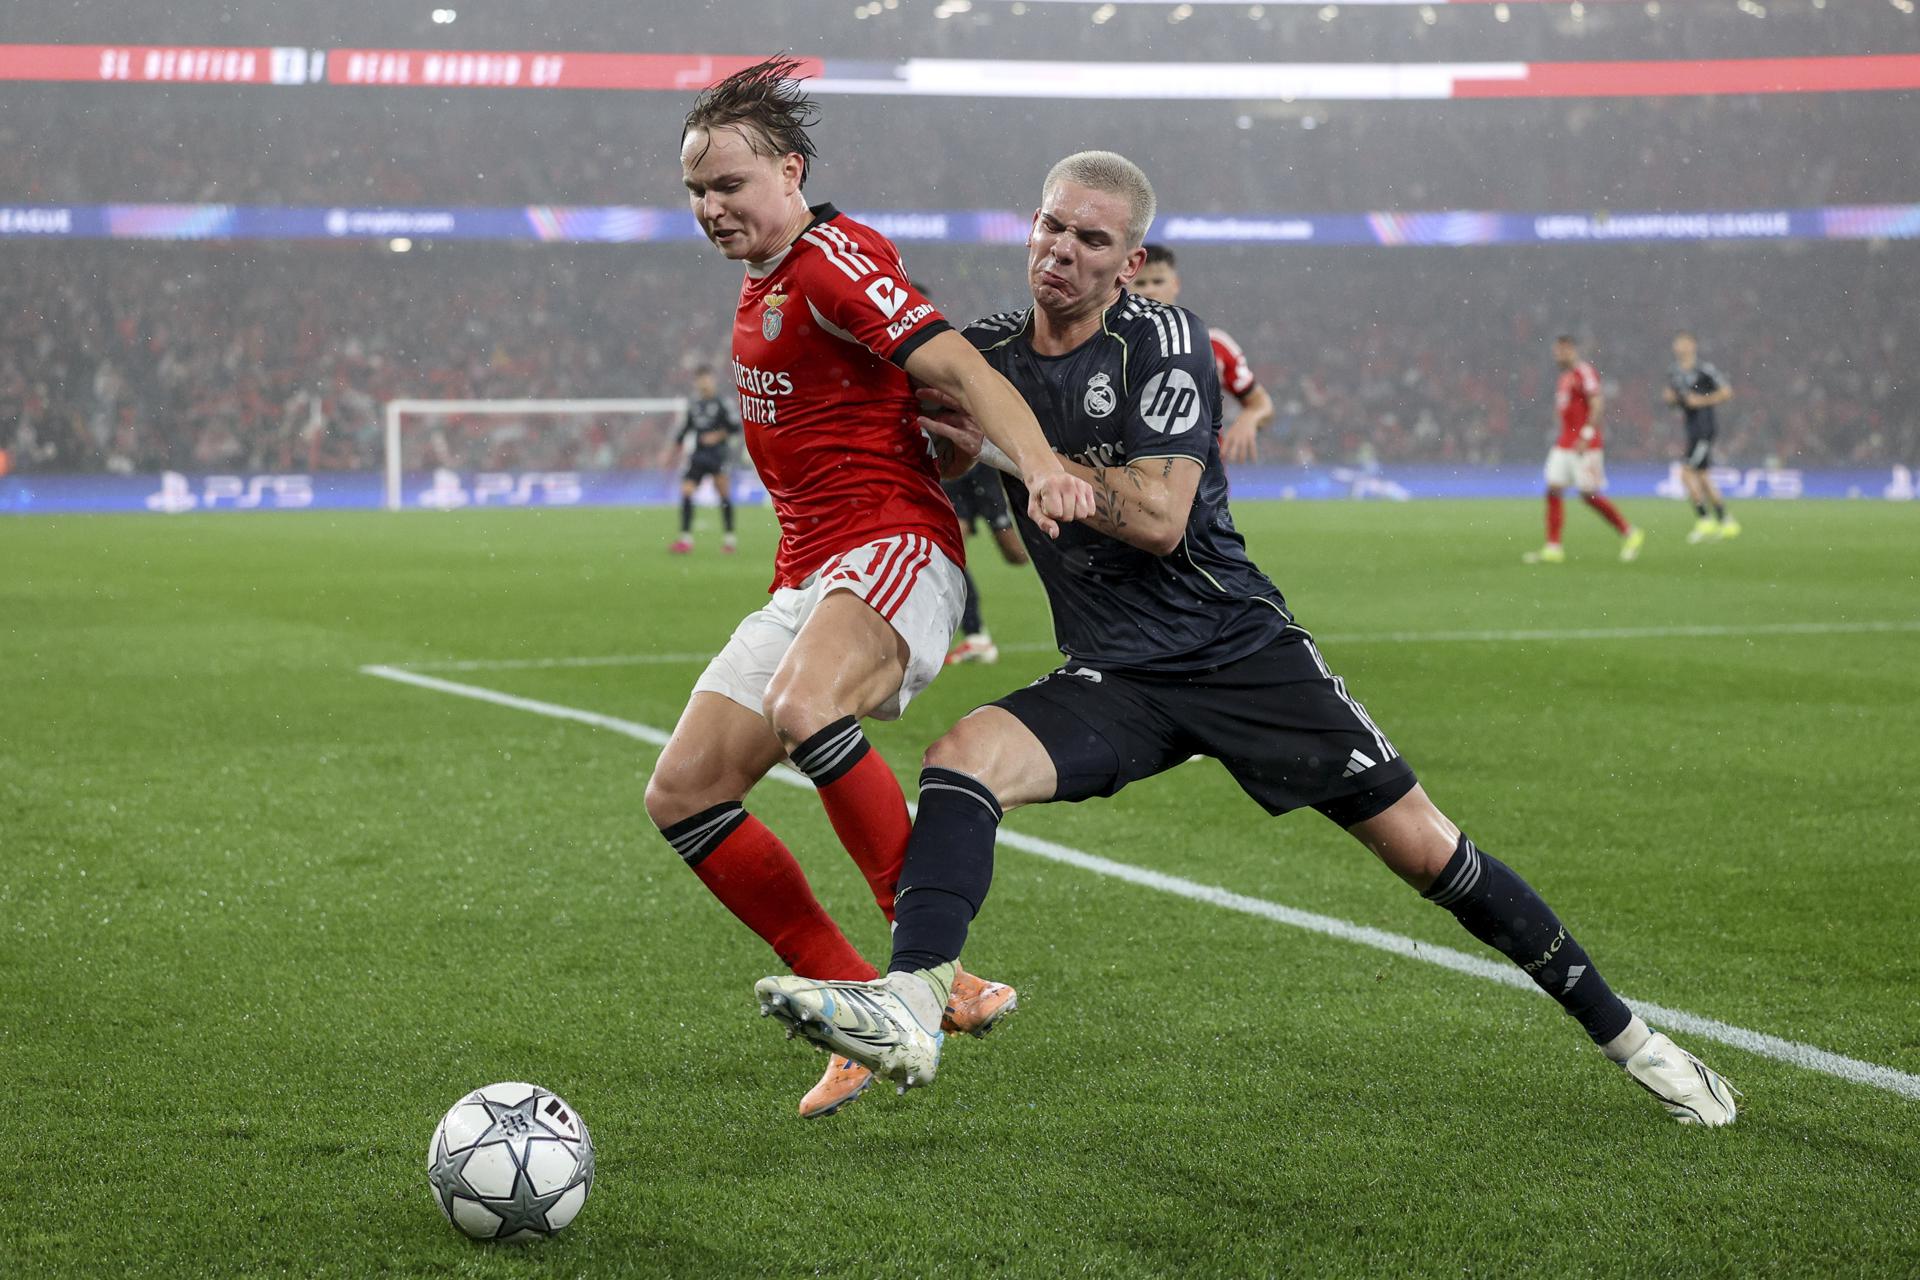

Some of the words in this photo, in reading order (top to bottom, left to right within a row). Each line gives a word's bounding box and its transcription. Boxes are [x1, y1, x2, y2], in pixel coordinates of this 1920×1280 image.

[741, 393, 777, 424] BETTER
[1144, 368, 1197, 434] hp
[204, 474, 314, 507] PS5
[474, 472, 582, 504] PS5
[1523, 925, 1566, 973] RMCF
